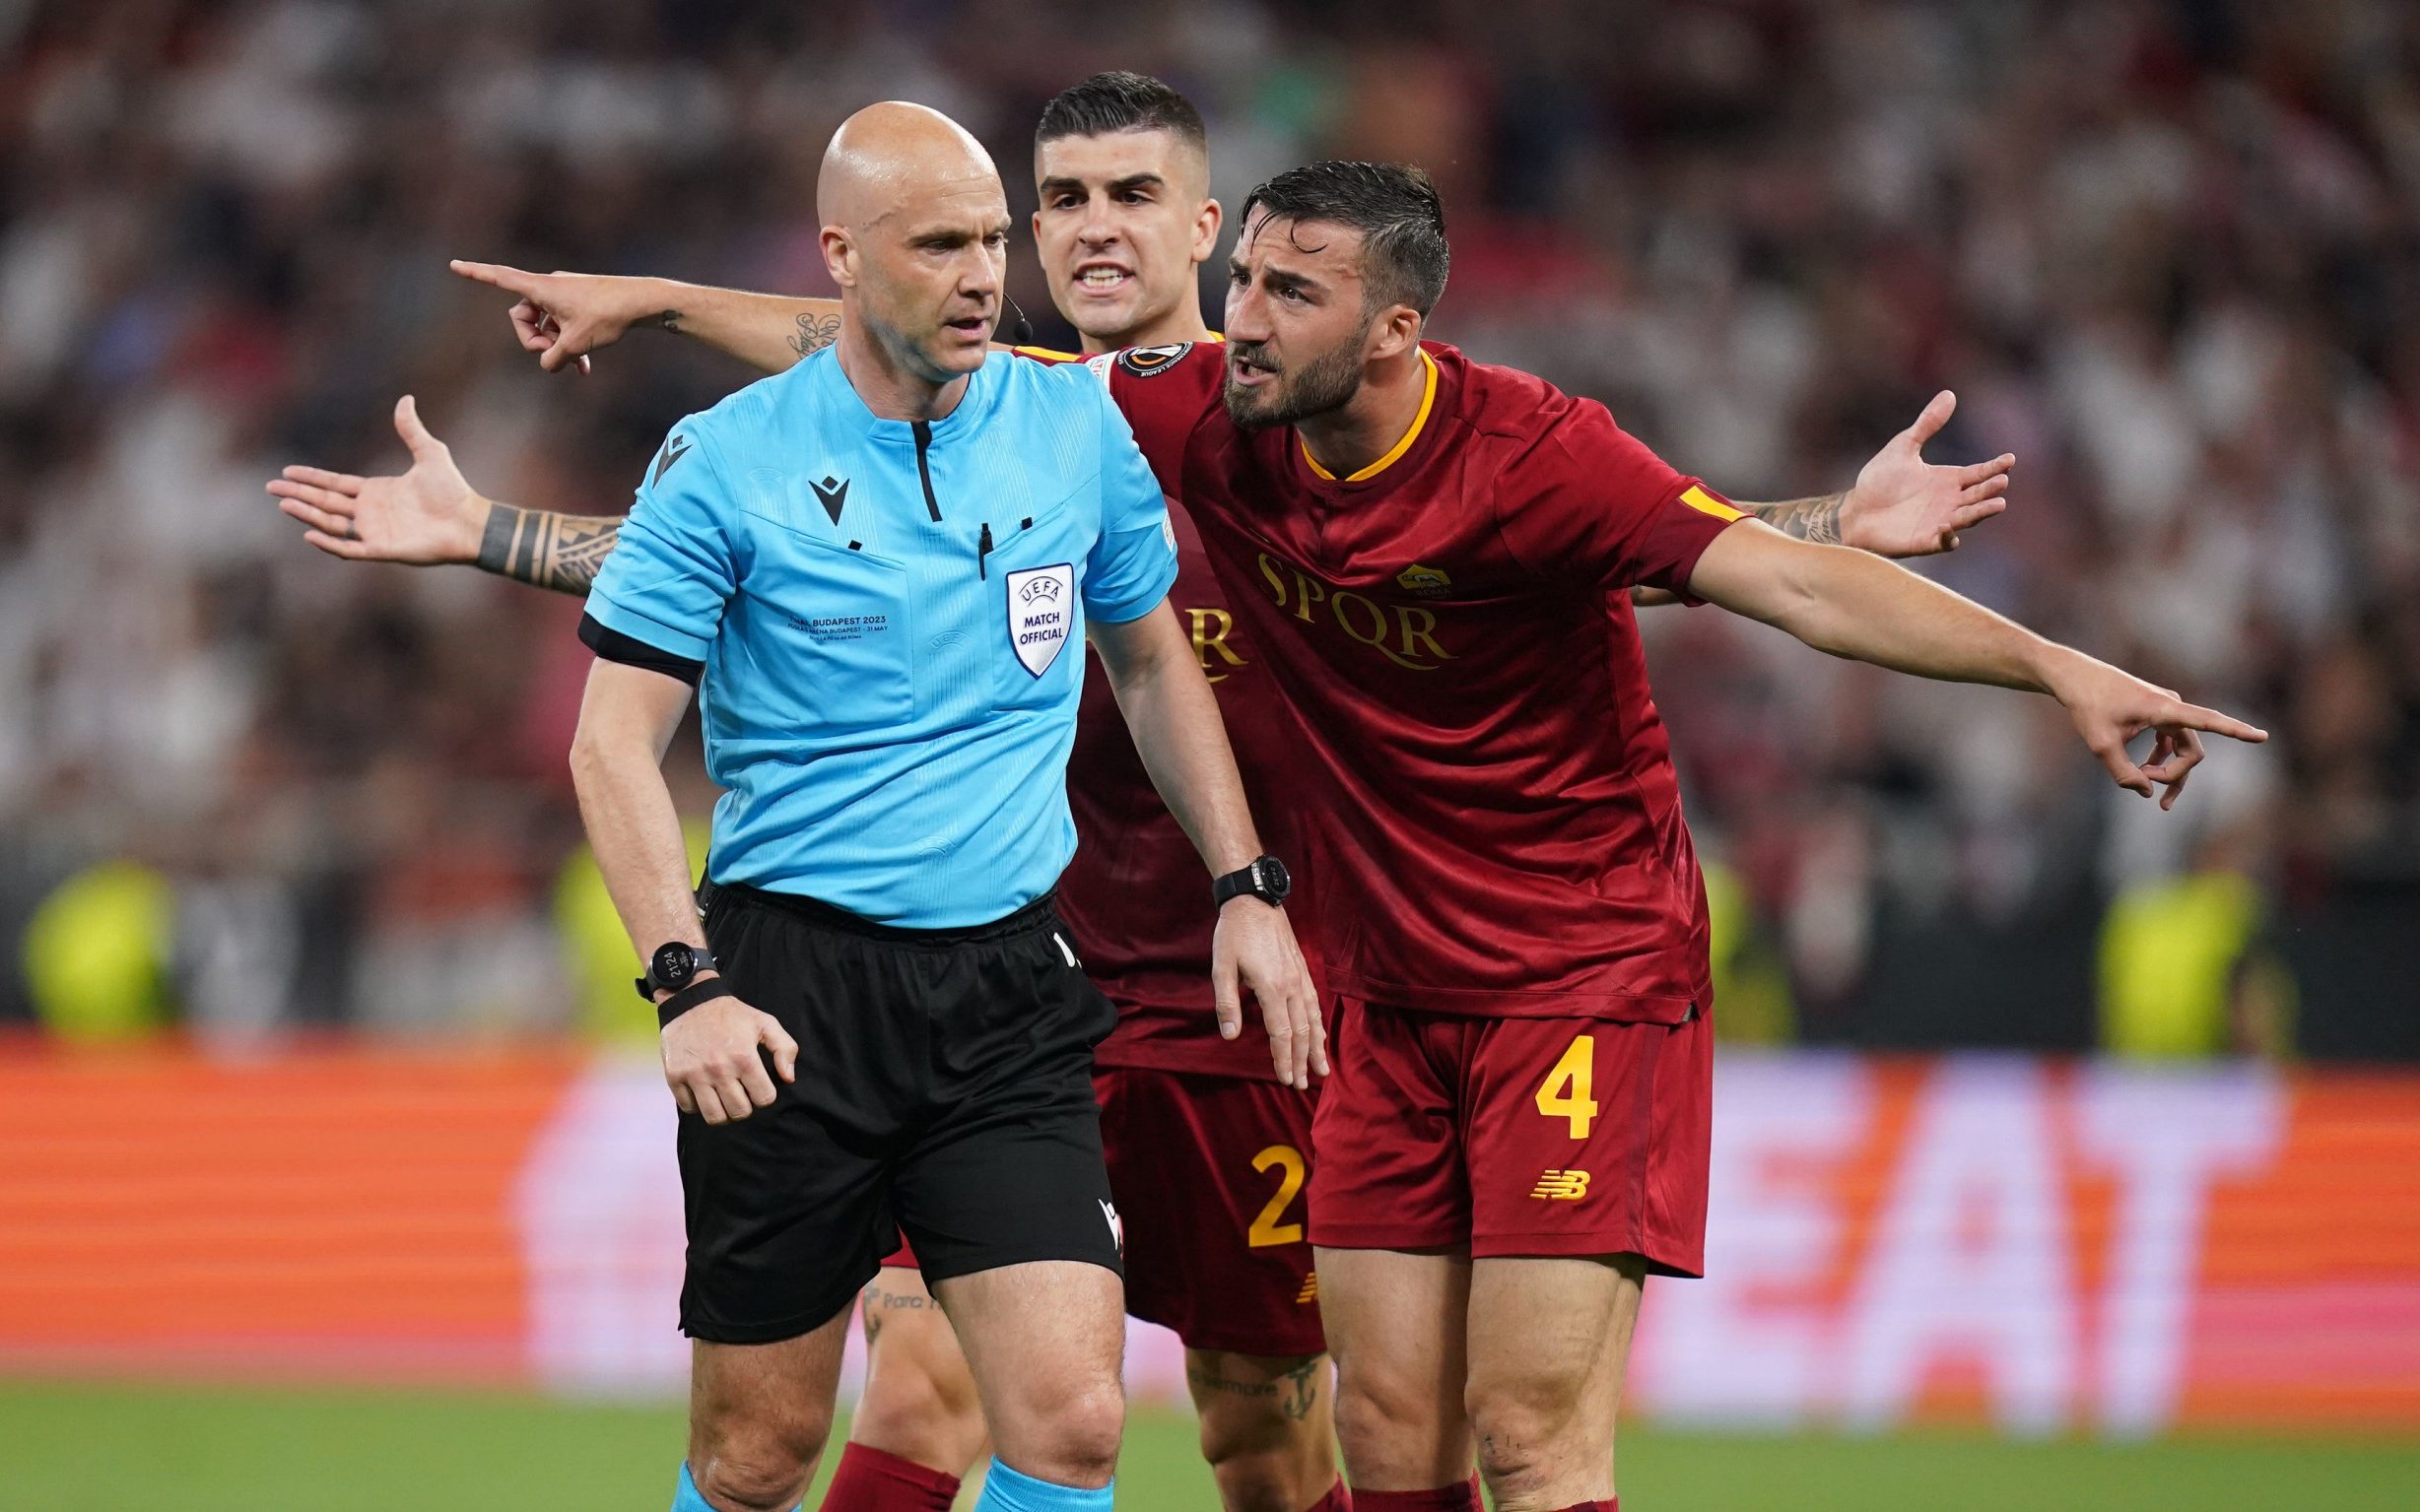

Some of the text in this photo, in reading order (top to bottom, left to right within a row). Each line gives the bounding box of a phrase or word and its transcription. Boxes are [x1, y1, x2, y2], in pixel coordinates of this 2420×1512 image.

[1021, 580, 1059, 602] UEFA
[812, 617, 860, 626] BUDAPEST
[863, 616, 886, 625] 2023
[1024, 612, 1060, 627] MATCH
[1258, 553, 1458, 670] SPQR
[1020, 627, 1063, 645] OFFICIAL
[664, 952, 682, 977] 21:24
[1535, 1035, 1598, 1140] 4
[1249, 1145, 1305, 1247] 2
